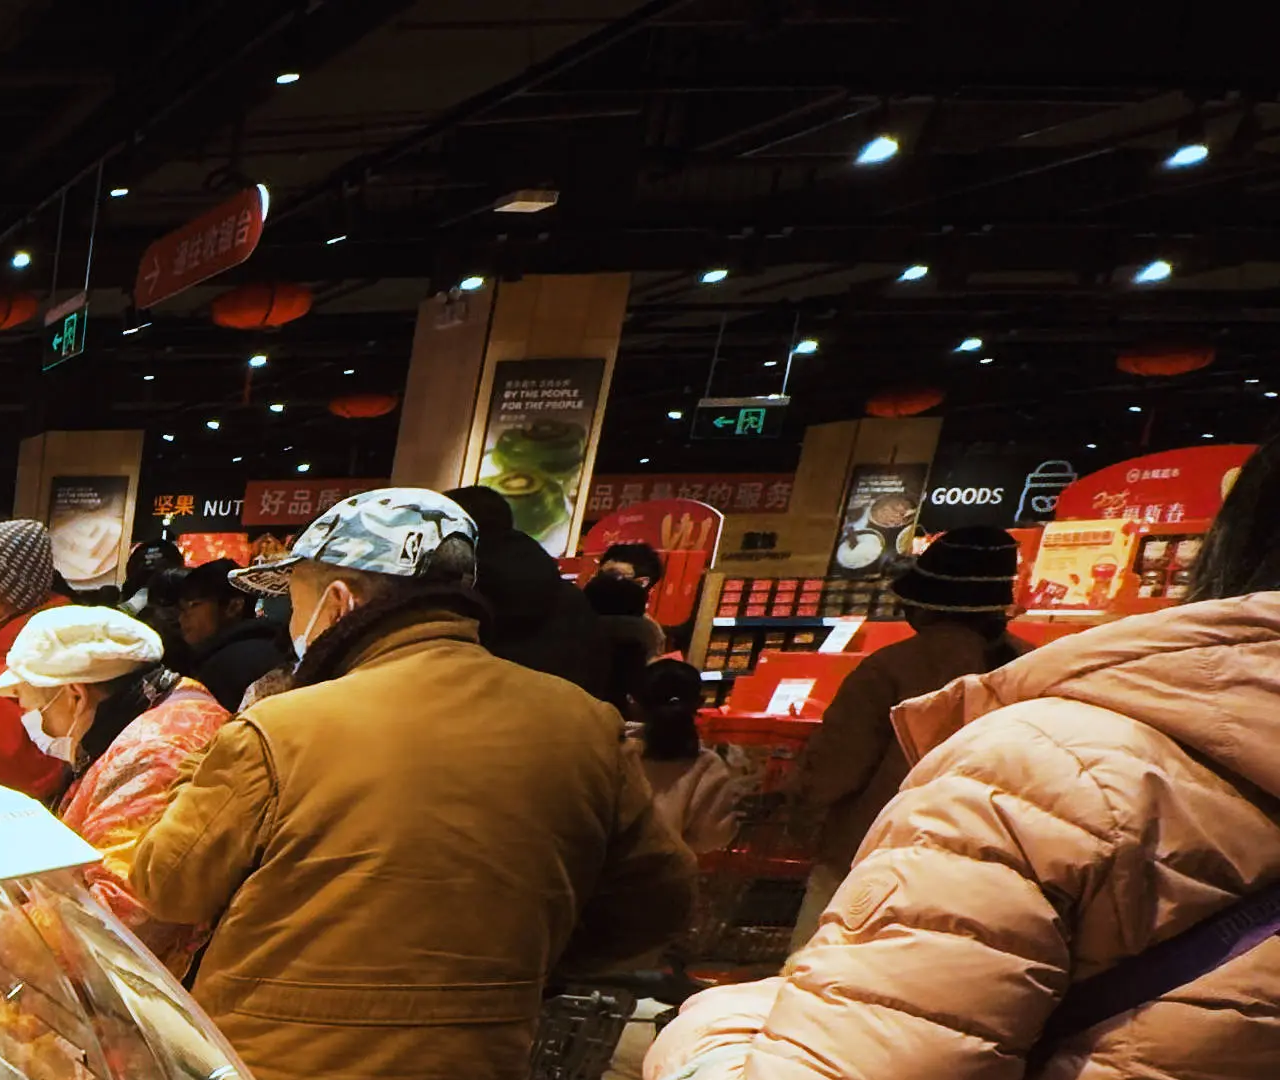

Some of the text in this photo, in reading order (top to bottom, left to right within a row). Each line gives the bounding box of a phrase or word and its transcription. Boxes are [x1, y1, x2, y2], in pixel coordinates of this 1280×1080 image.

[540, 389, 579, 398] PEOPLE
[500, 401, 523, 411] FOR
[544, 400, 584, 410] PEOPLE
[259, 488, 366, 516] 好品质
[931, 487, 1004, 505] GOODS
[152, 494, 244, 517] 坚果 NUT
